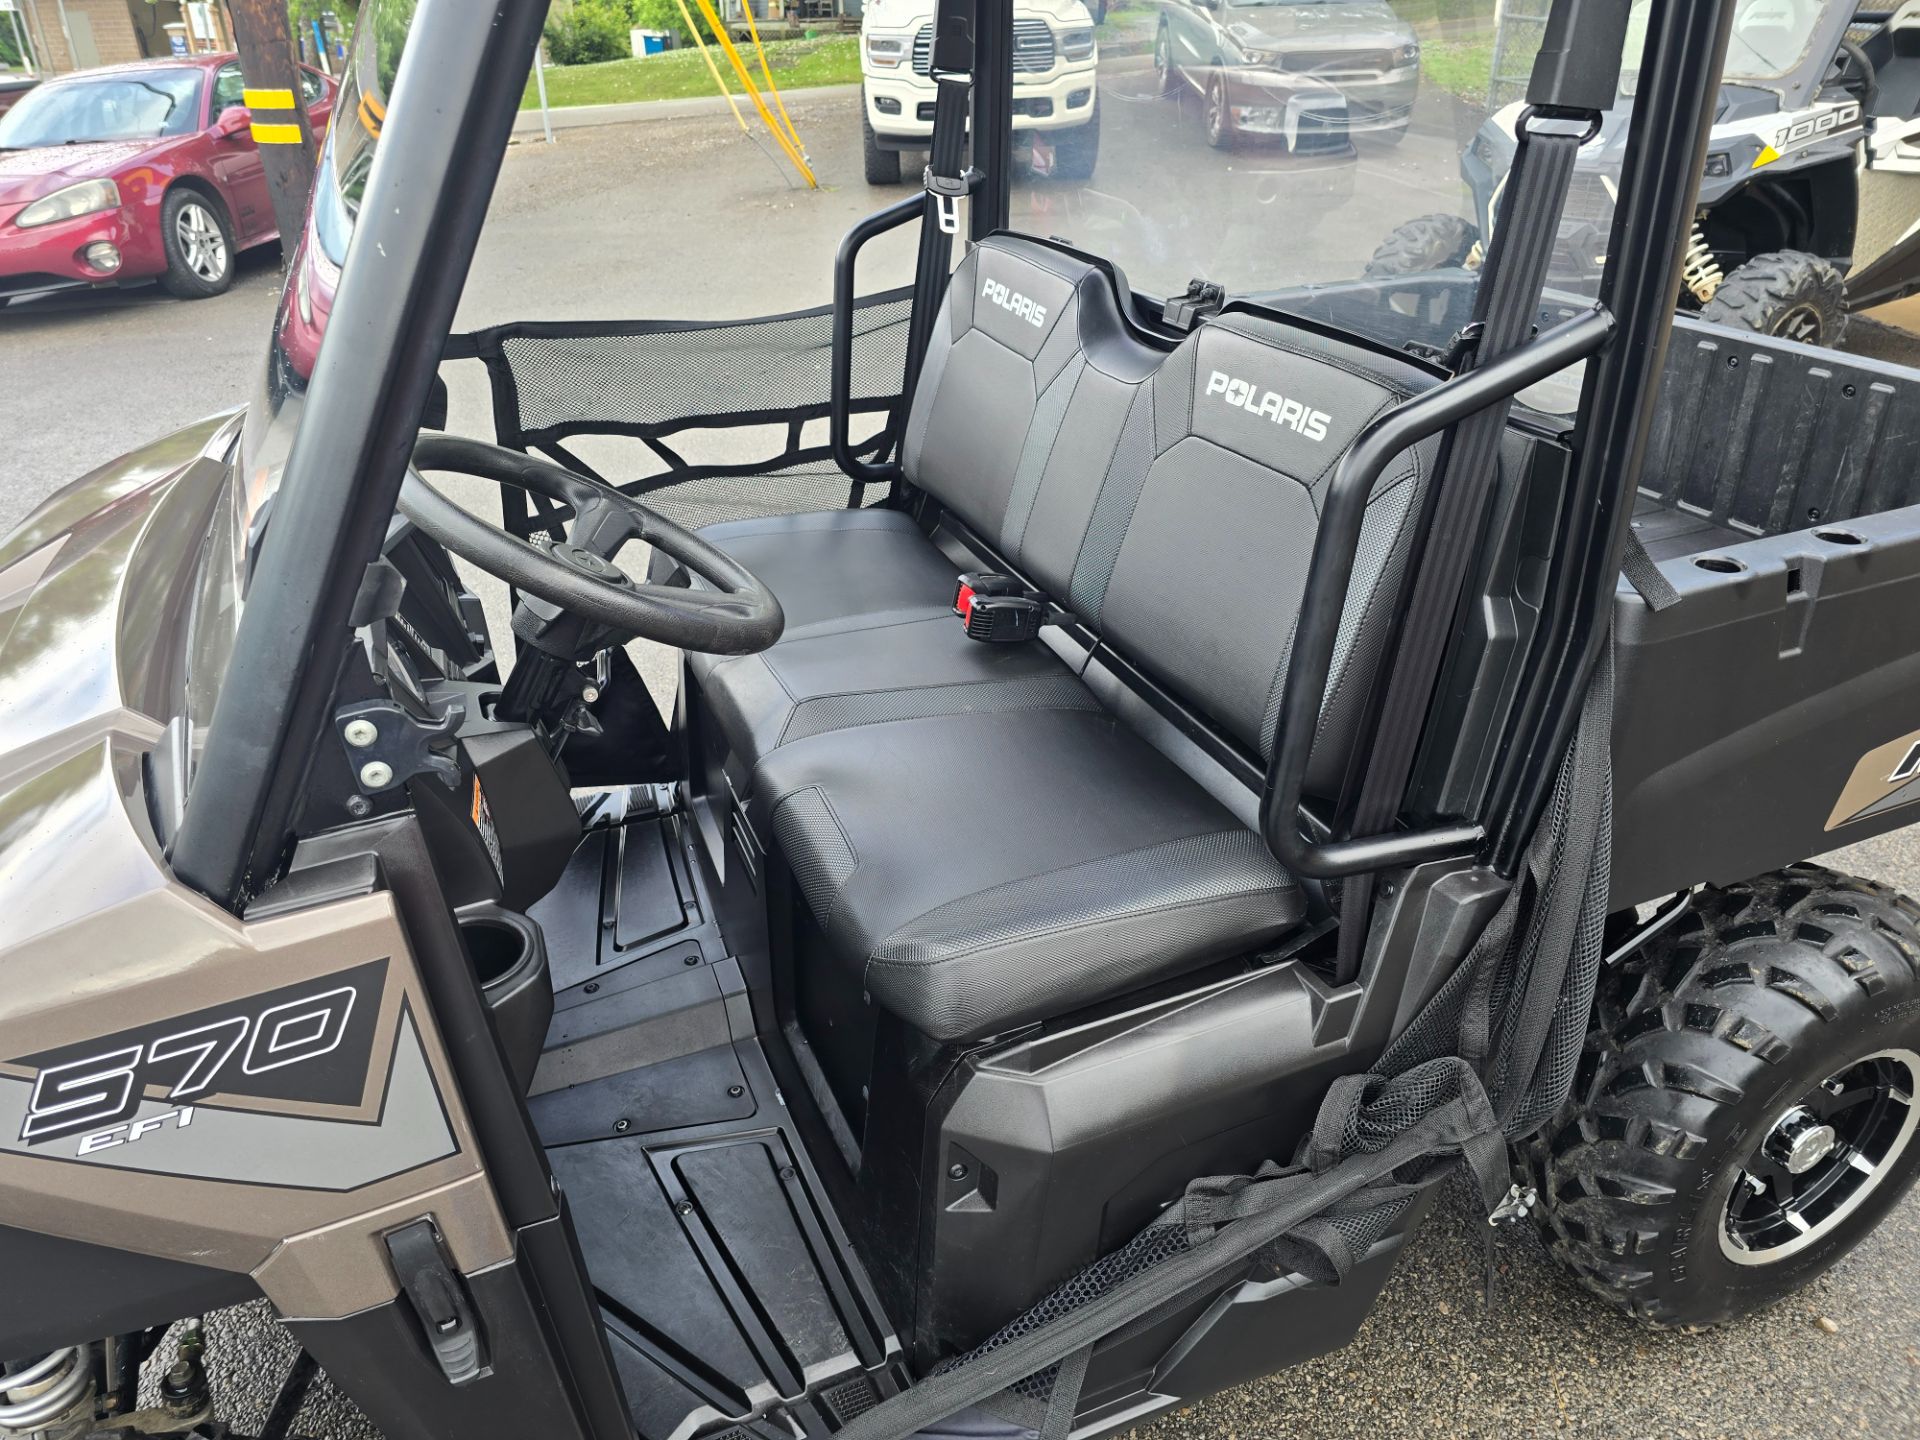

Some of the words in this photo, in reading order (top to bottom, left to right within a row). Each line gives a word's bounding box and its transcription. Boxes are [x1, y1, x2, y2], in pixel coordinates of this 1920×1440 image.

[1775, 104, 1860, 148] 1000
[981, 277, 1047, 328] POLARIS
[1205, 369, 1332, 442] POLARIS
[20, 985, 357, 1141] 570
[76, 1105, 194, 1157] EFI
